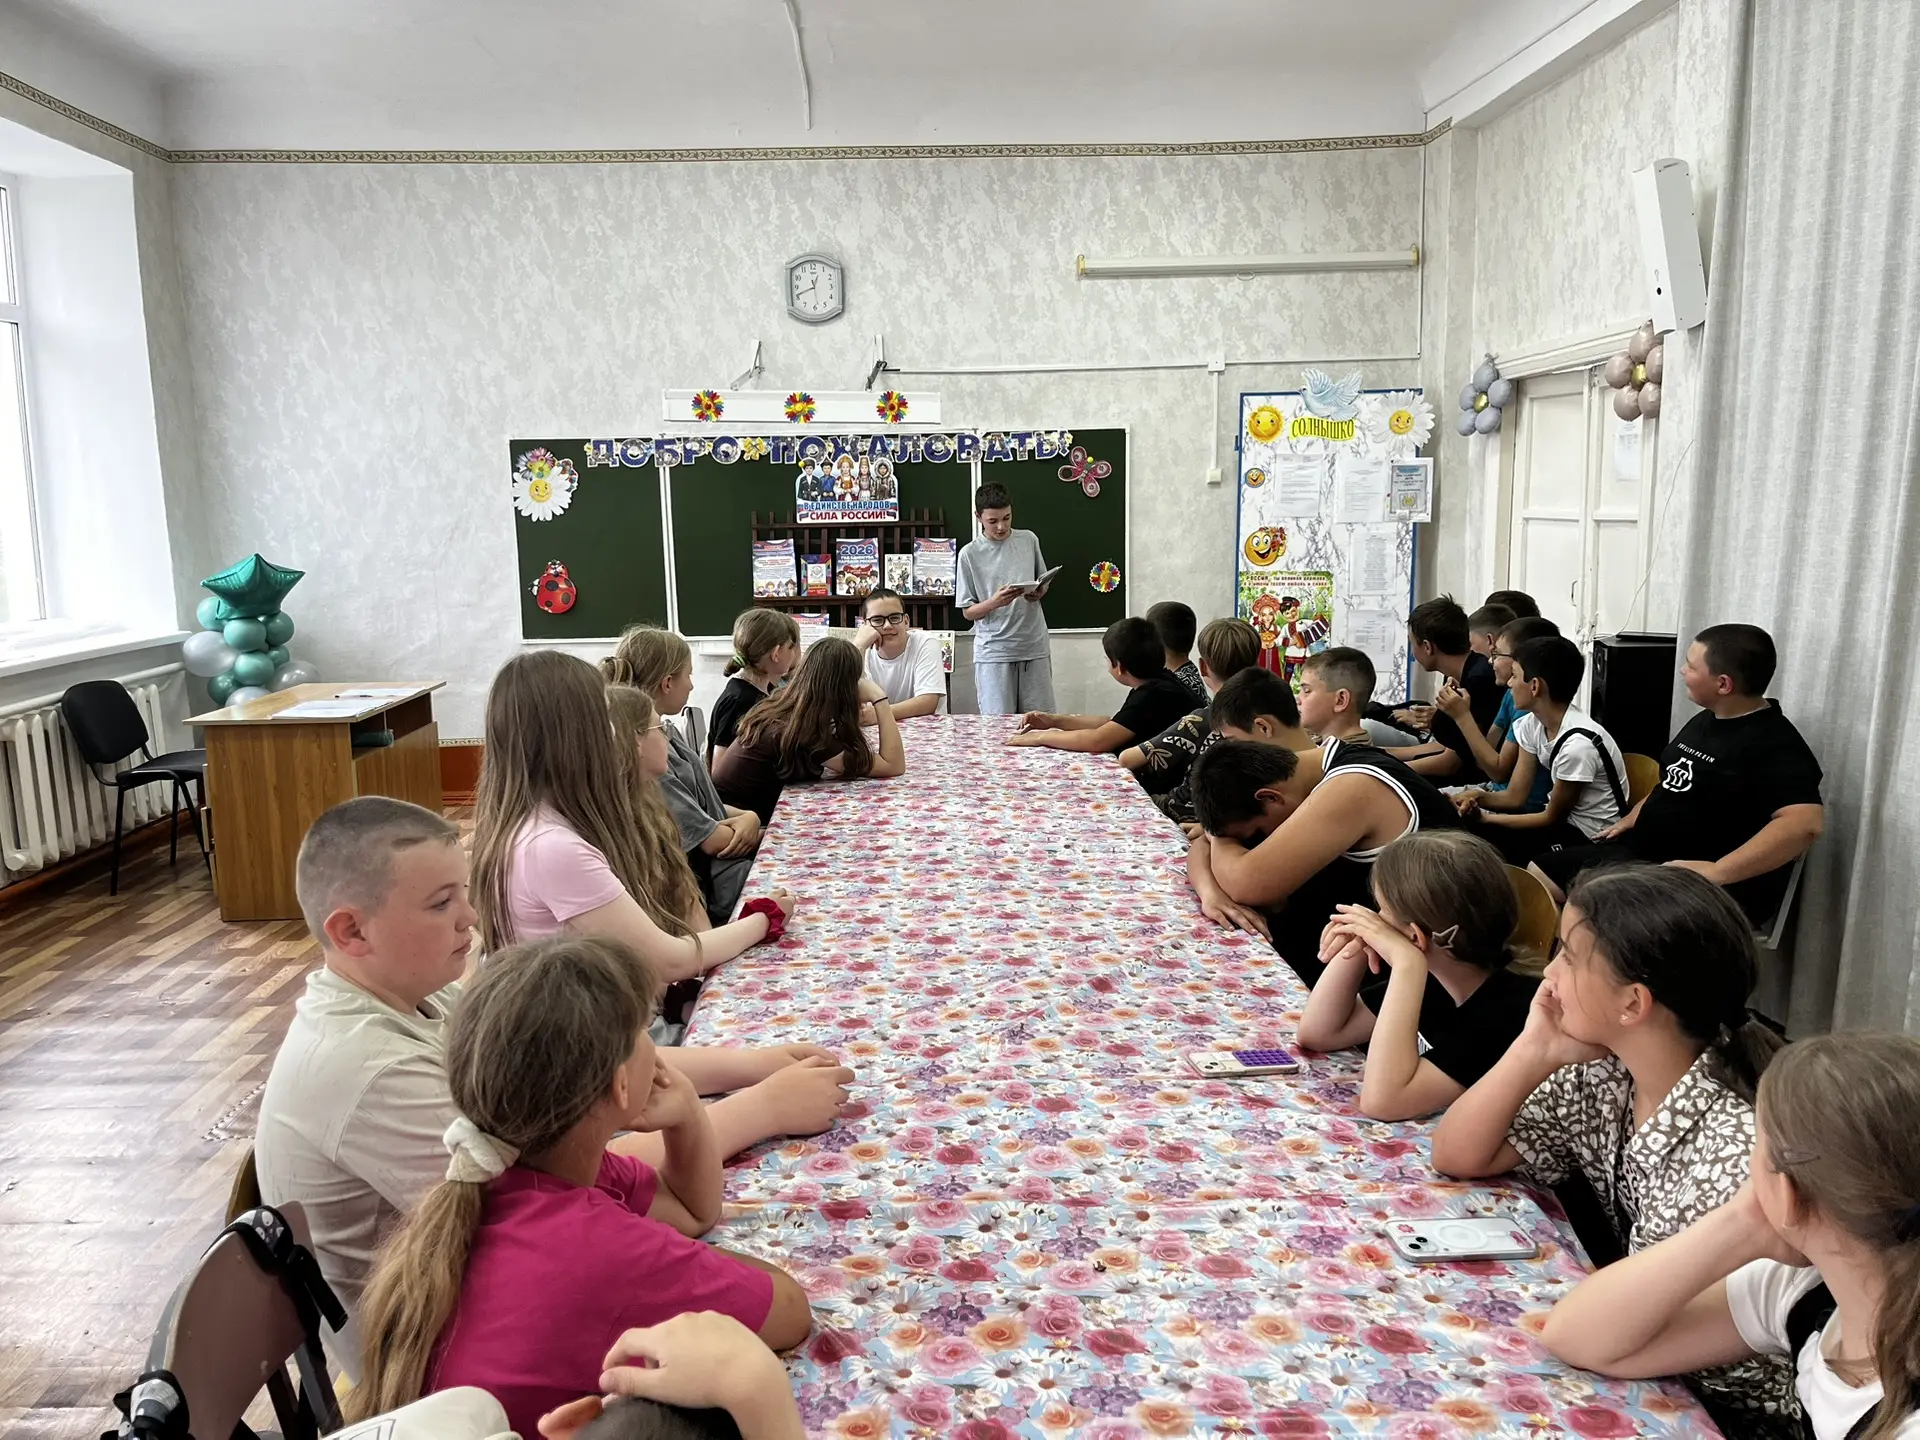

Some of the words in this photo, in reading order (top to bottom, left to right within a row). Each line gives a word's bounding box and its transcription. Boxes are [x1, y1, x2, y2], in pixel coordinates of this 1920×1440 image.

[1292, 418, 1354, 439] СОЛНЫШКО
[587, 436, 742, 467] ДОБРО
[769, 430, 1071, 464] ПОЖАЛОВАТЬ!
[811, 501, 850, 510] ЕДИНСТВЕ
[851, 501, 890, 509] НАРОДОВ
[810, 512, 838, 520] СИЛА
[841, 511, 886, 519] РОССИИ!
[841, 545, 874, 555] 2026
